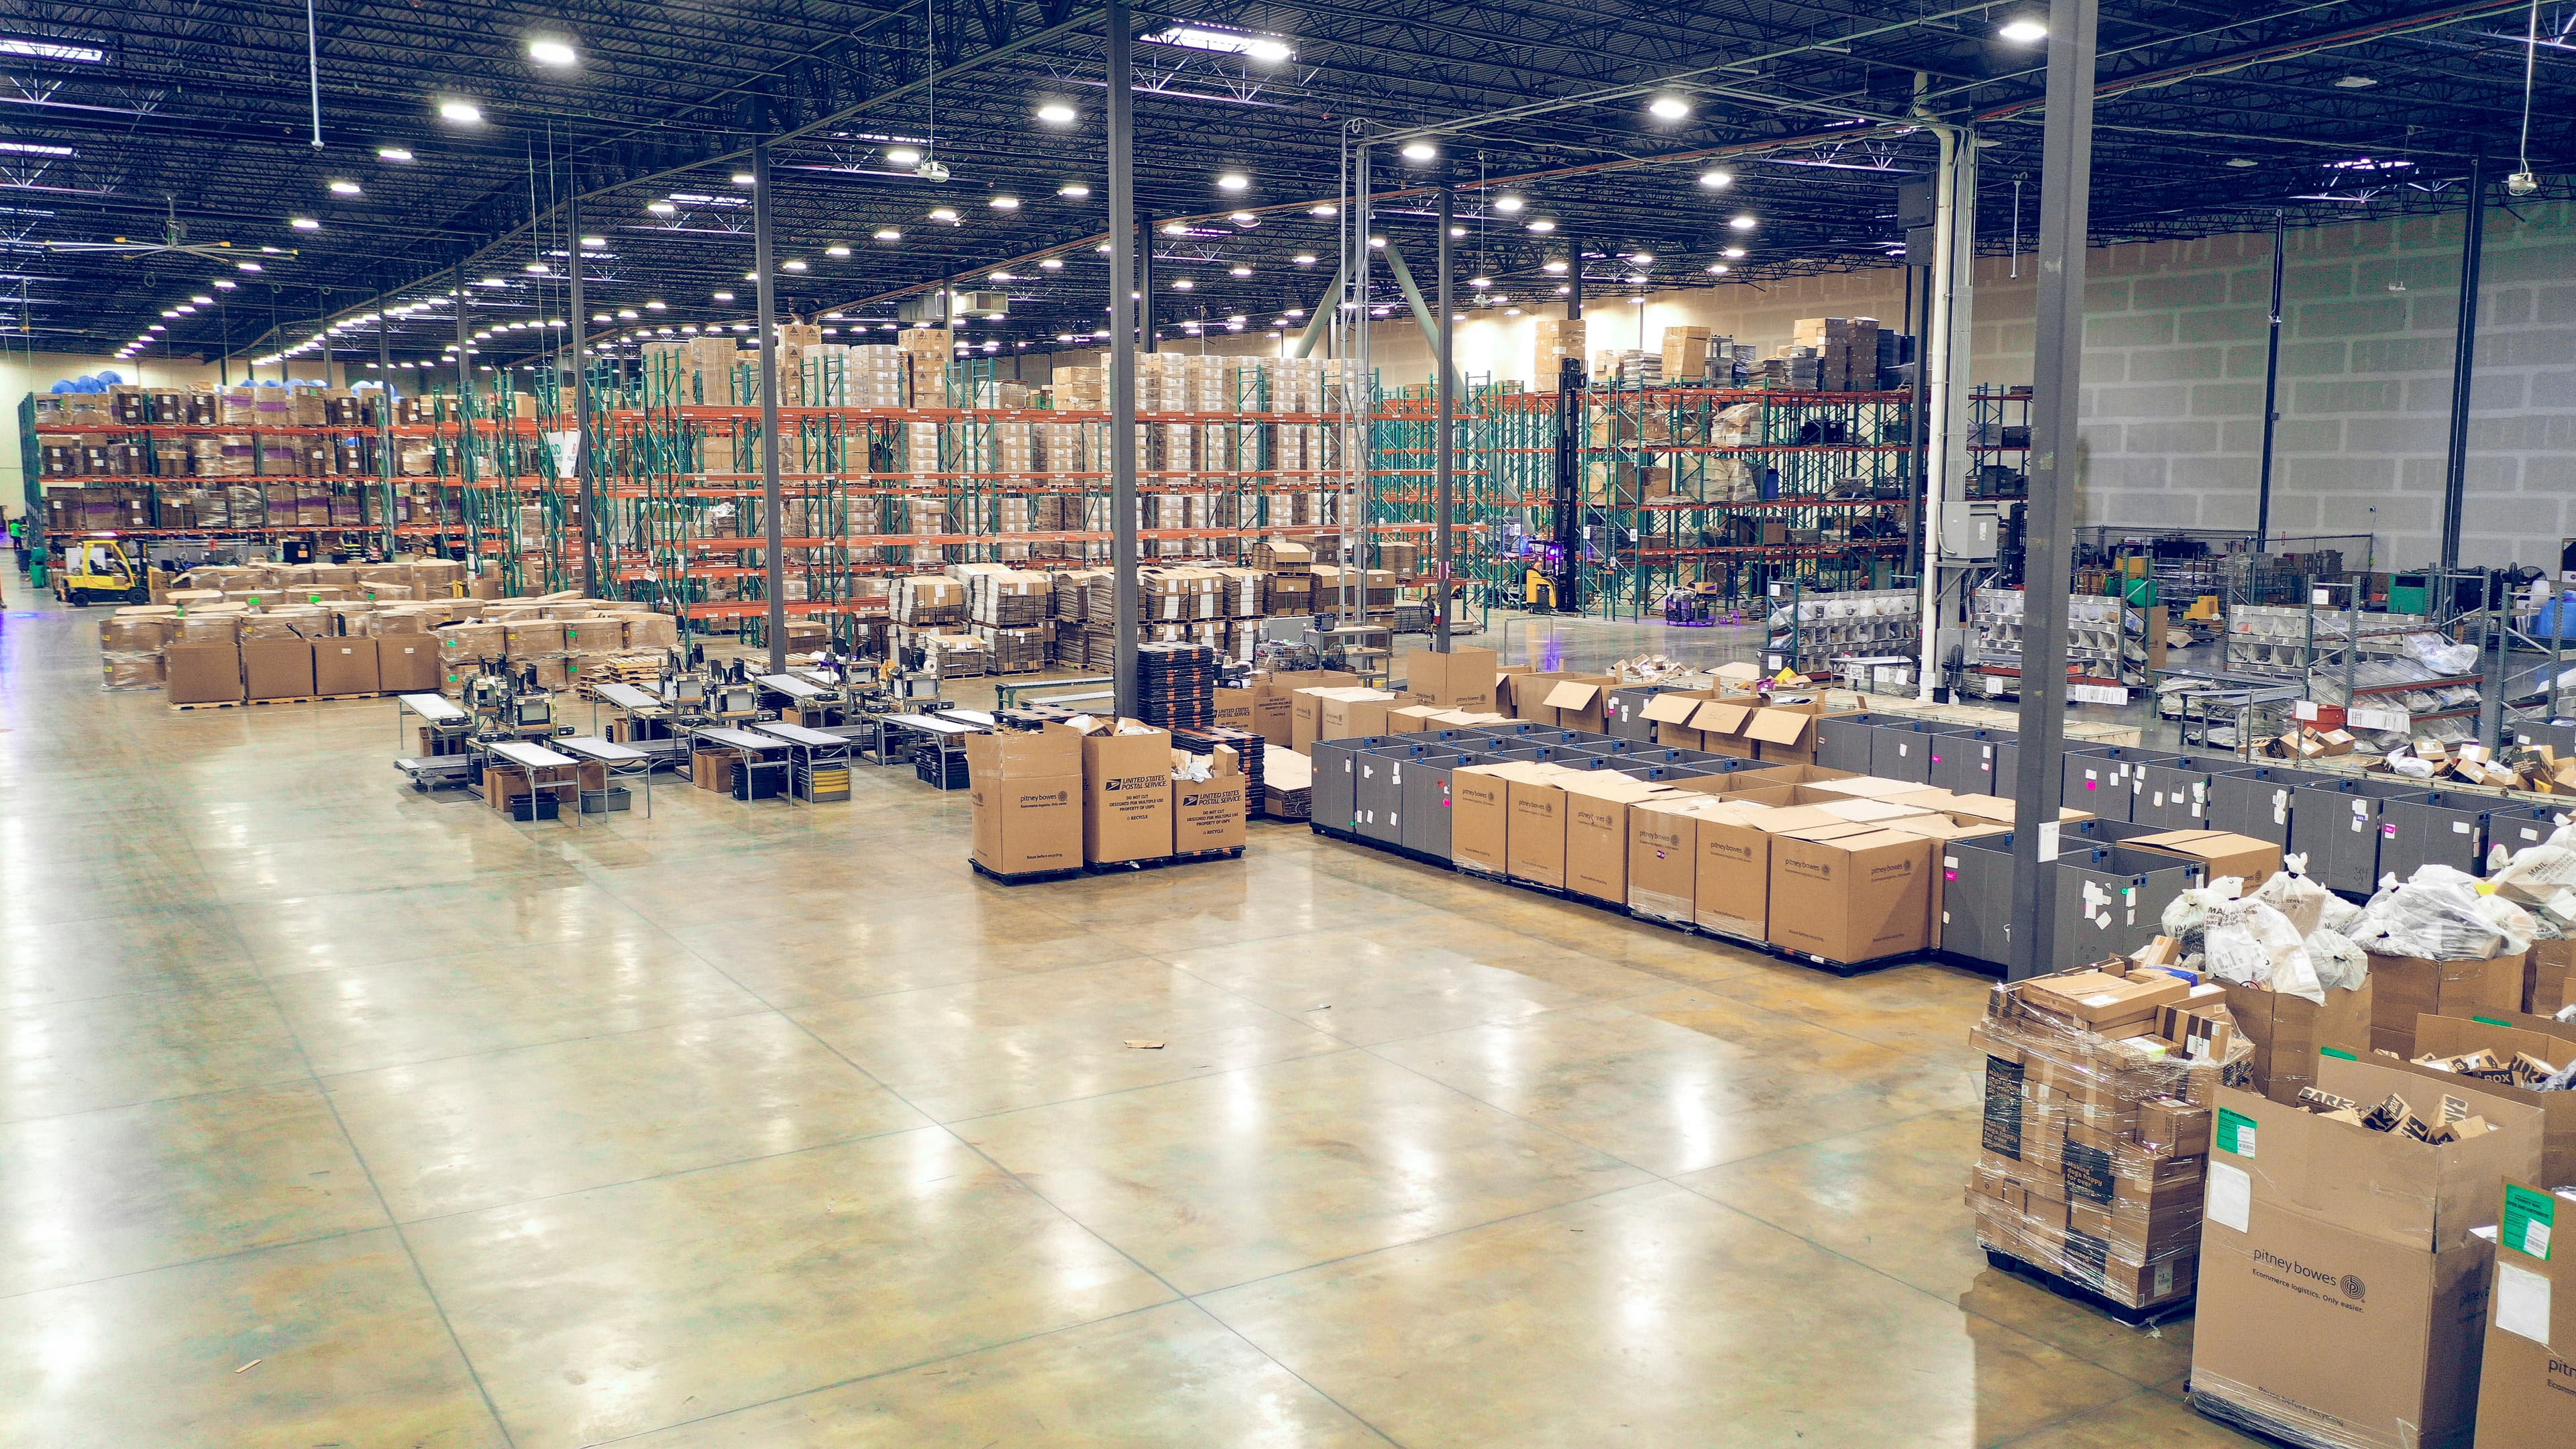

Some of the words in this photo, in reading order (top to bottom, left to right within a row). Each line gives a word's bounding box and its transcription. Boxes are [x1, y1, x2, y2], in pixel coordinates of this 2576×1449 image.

[1122, 776, 1145, 784] UNITED
[1122, 782, 1144, 790] POSTAL
[1020, 795, 1038, 803] pitney
[1222, 790, 1240, 798] STATES
[1462, 789, 1474, 797] pitney
[1518, 800, 1532, 808] pitney
[1578, 811, 1591, 820] pitney
[1640, 830, 1654, 839] pitney
[1654, 832, 1670, 841] bowes
[1711, 842, 1726, 851] pitney
[1726, 844, 1742, 853] bowes
[1786, 859, 1801, 869] pitney
[1802, 861, 1820, 871] bowes
[1871, 867, 1887, 875] pitney
[1887, 863, 1902, 871] bowes
[2528, 862, 2548, 877] MAIL
[2300, 1087, 2355, 1109] BARK
[2387, 1096, 2401, 1114] BOX
[1999, 1129, 2018, 1142] happy
[2068, 1161, 2090, 1175] Making
[2067, 1168, 2082, 1177] dogs
[2084, 1174, 2102, 1187] happy
[2067, 1173, 2077, 1181] for
[2077, 1177, 2092, 1187] over
[2254, 1249, 2292, 1273] pitney
[2294, 1260, 2337, 1286] bowes
[2253, 1269, 2290, 1287] Ecommerce
[2292, 1283, 2321, 1299] logistics.
[2322, 1295, 2339, 1305] Only
[2341, 1301, 2364, 1313] easier.
